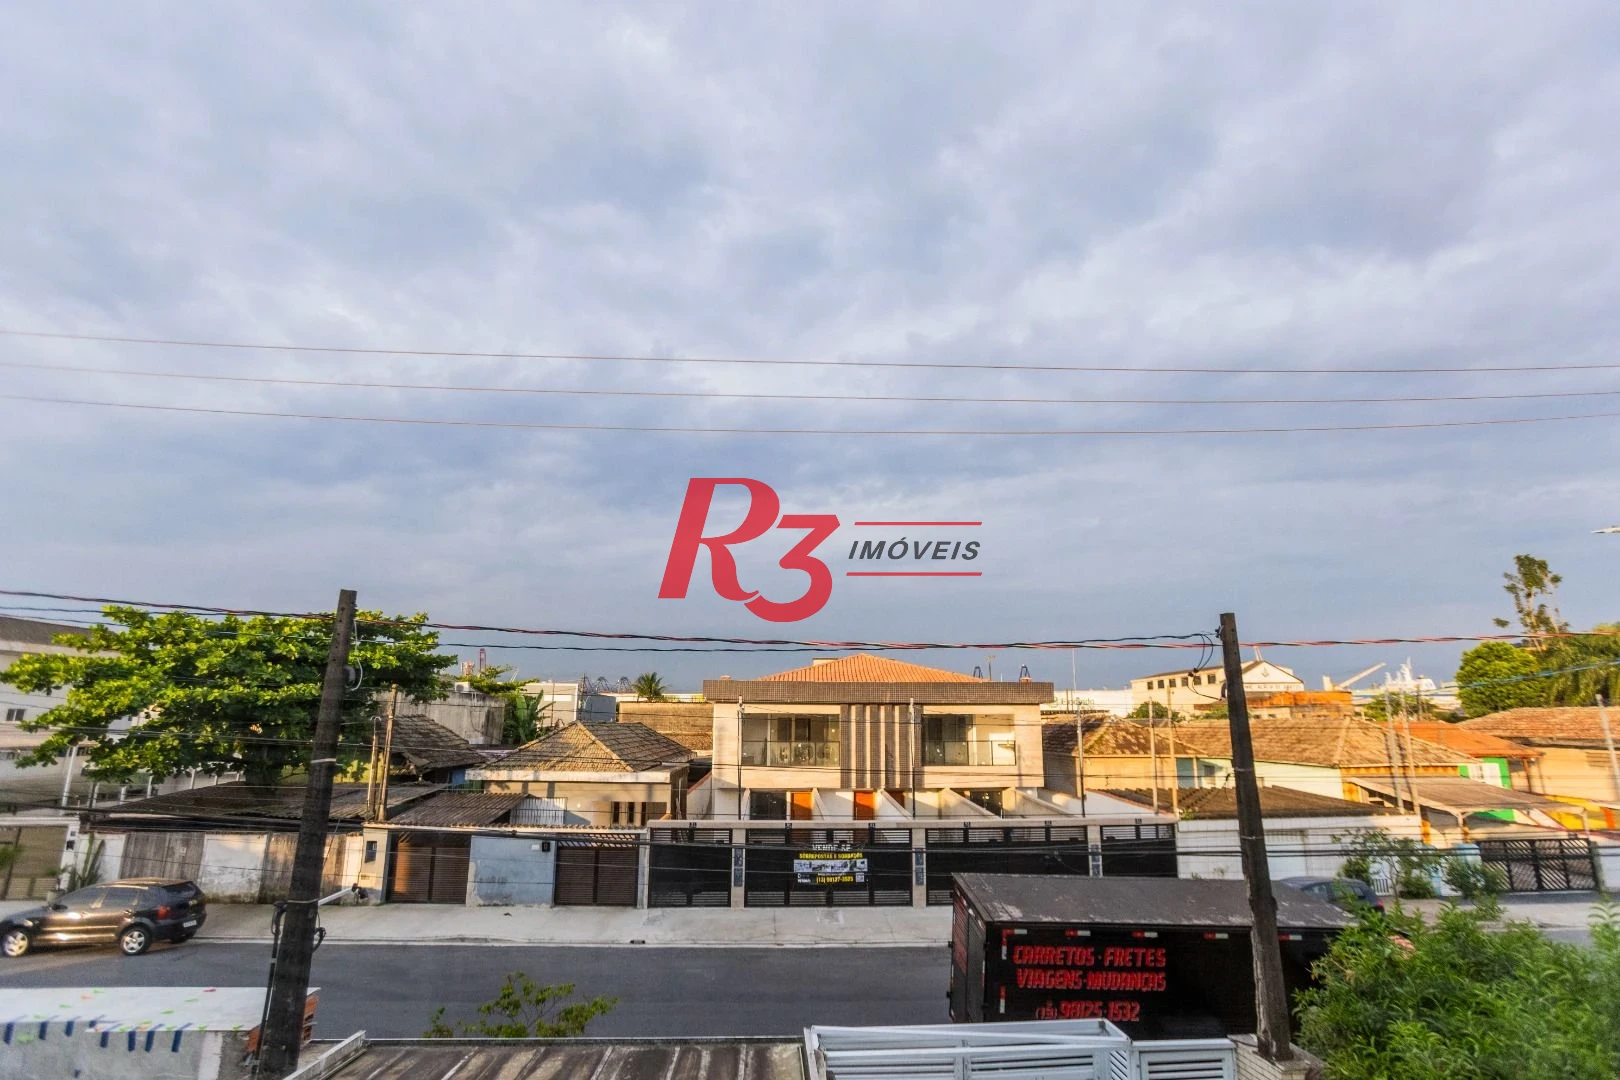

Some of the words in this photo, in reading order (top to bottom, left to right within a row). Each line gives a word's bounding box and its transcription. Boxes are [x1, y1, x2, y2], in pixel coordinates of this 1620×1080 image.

[1013, 945, 1094, 966] CARRETOS
[1103, 947, 1166, 967] FRETES
[1016, 968, 1083, 990] VIAGENS
